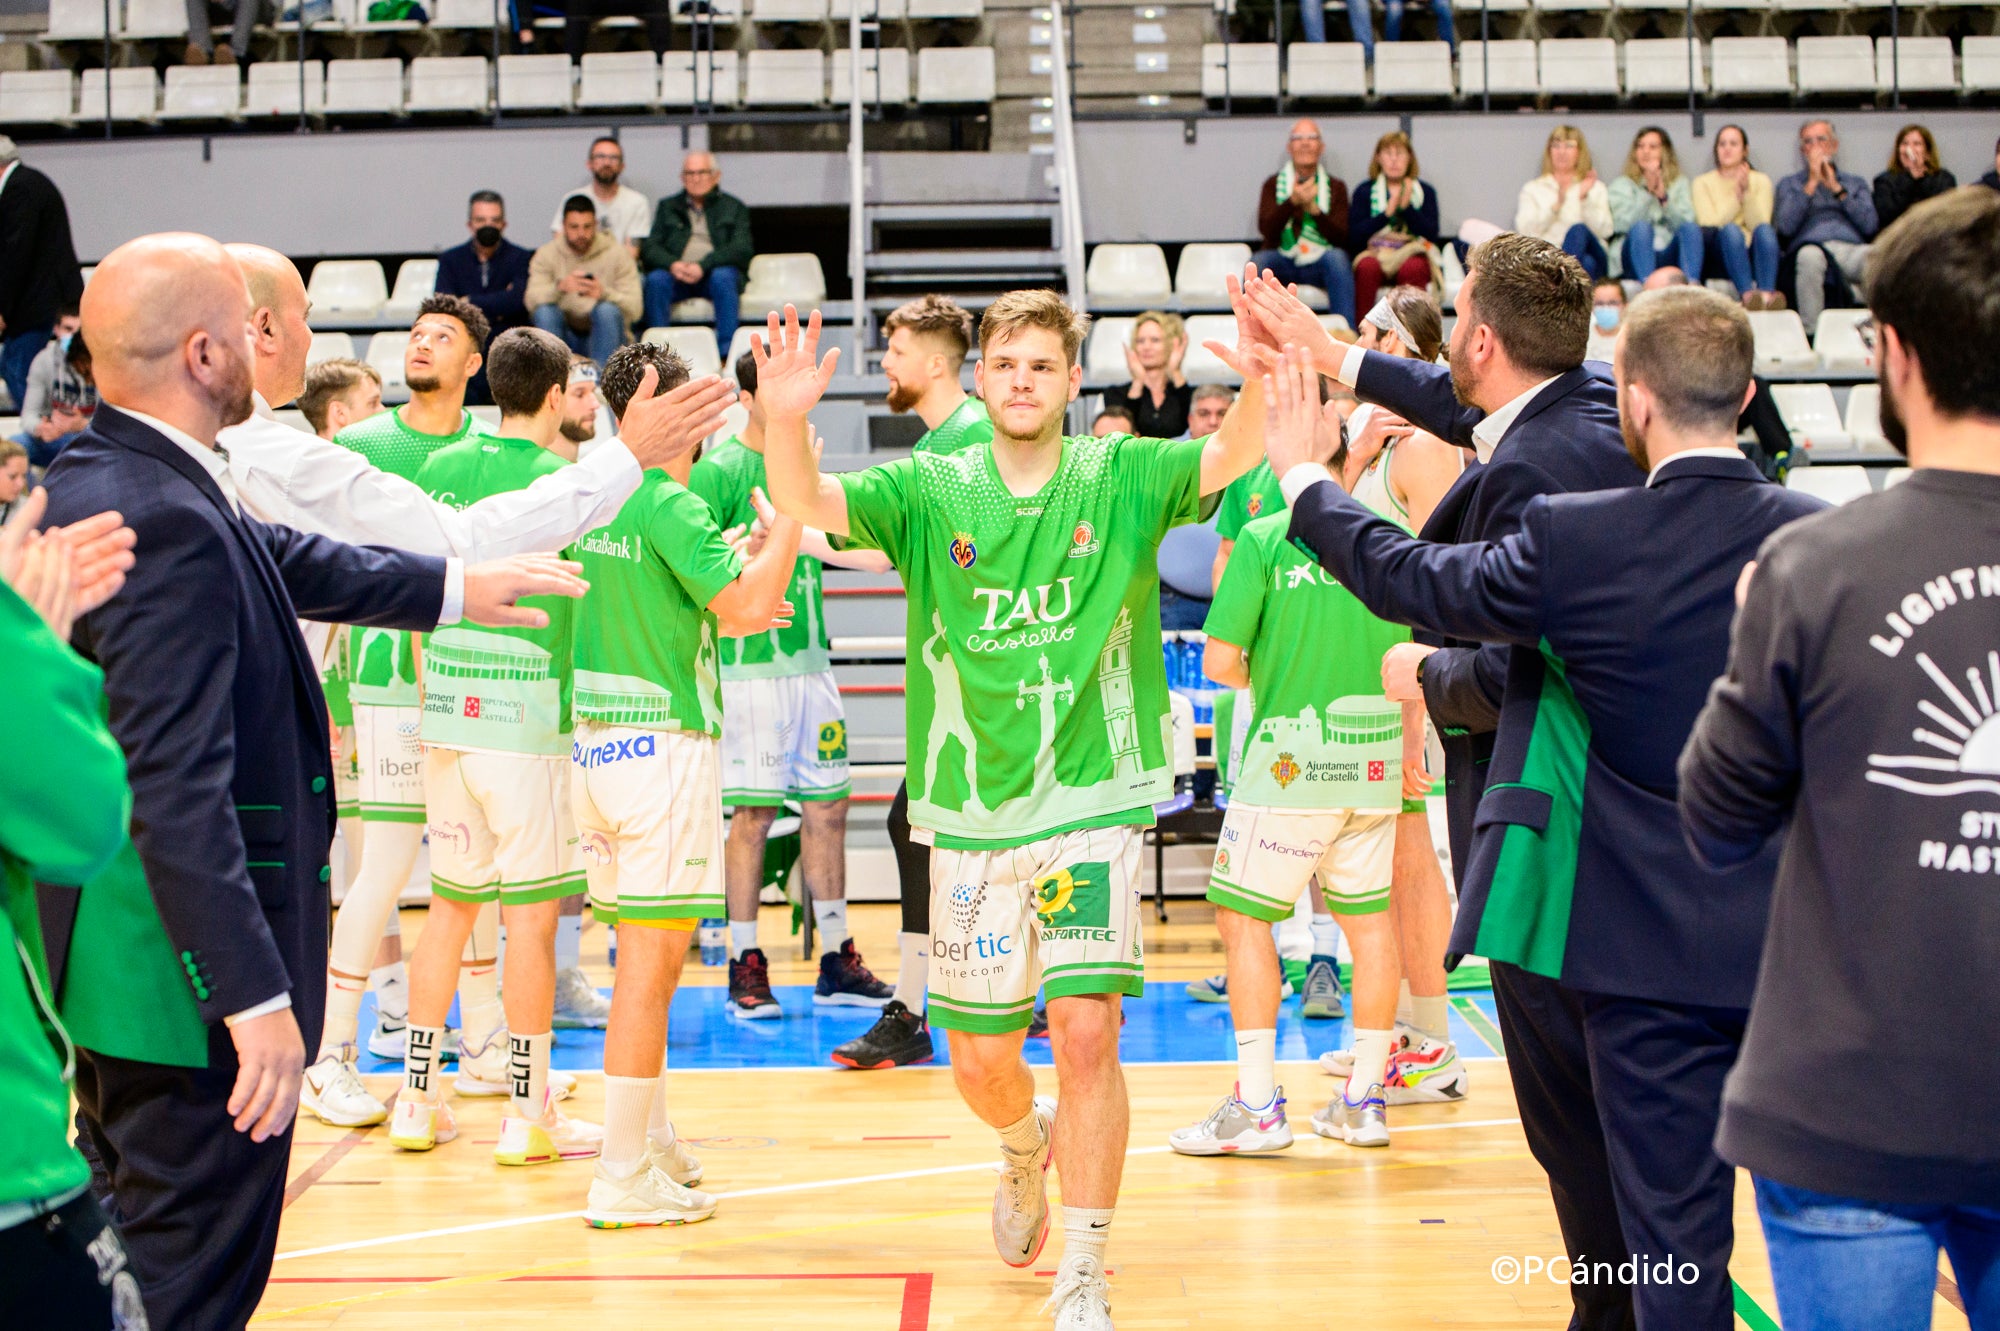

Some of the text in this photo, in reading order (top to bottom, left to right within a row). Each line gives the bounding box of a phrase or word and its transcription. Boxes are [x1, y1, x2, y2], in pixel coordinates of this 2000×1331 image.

[581, 532, 631, 560] CaixaBank
[972, 576, 1075, 631] TAU
[966, 623, 1077, 653] Castelló
[1306, 760, 1359, 773] Ajuntament
[1305, 771, 1359, 782] de Castelló
[1223, 826, 1239, 842] TAU
[939, 964, 1004, 977] telecom
